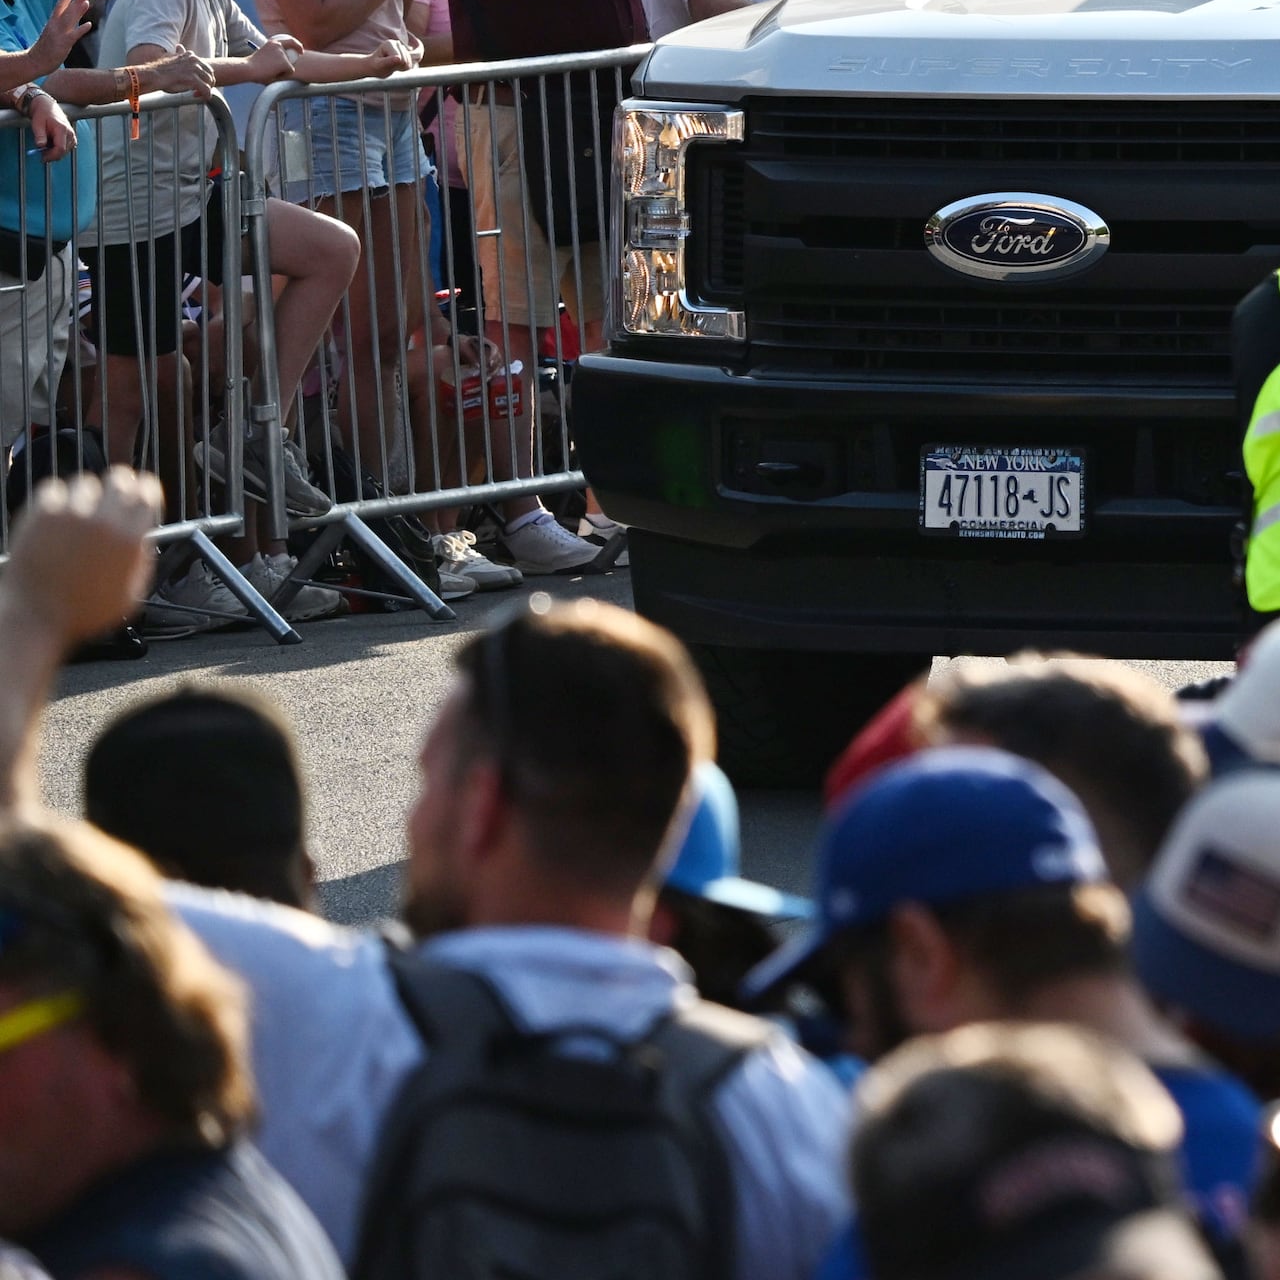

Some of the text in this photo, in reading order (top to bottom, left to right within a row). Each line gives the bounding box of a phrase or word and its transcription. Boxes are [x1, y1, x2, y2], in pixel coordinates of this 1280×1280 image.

[828, 55, 1252, 79] SUPER DUTY
[971, 215, 1057, 255] Ford
[963, 455, 1046, 471] NEW YORK
[938, 474, 1020, 518] 47118
[1040, 475, 1072, 518] JS
[960, 520, 1045, 530] COMMERCIAL
